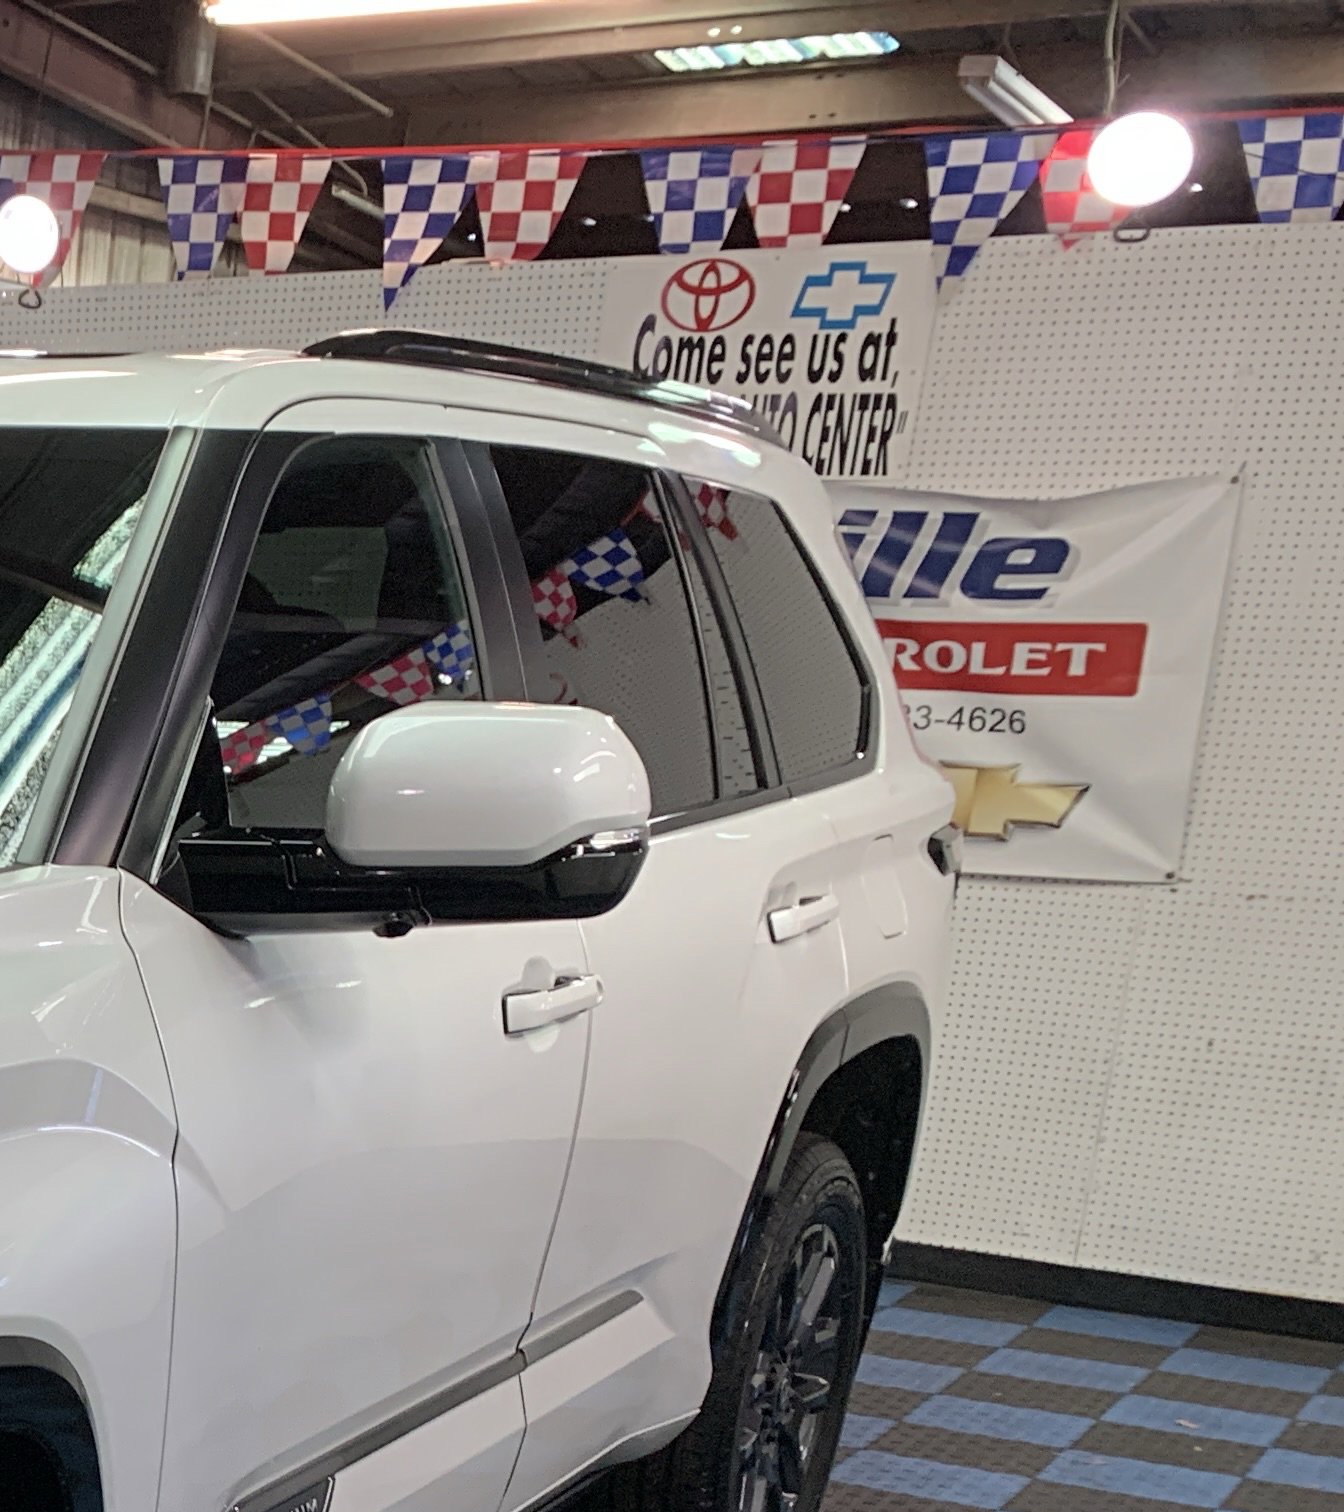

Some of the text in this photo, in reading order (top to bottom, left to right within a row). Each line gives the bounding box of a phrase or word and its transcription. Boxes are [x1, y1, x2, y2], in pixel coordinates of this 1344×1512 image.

[632, 314, 899, 388] Come see us at,
[903, 704, 1026, 734] 3-4626
